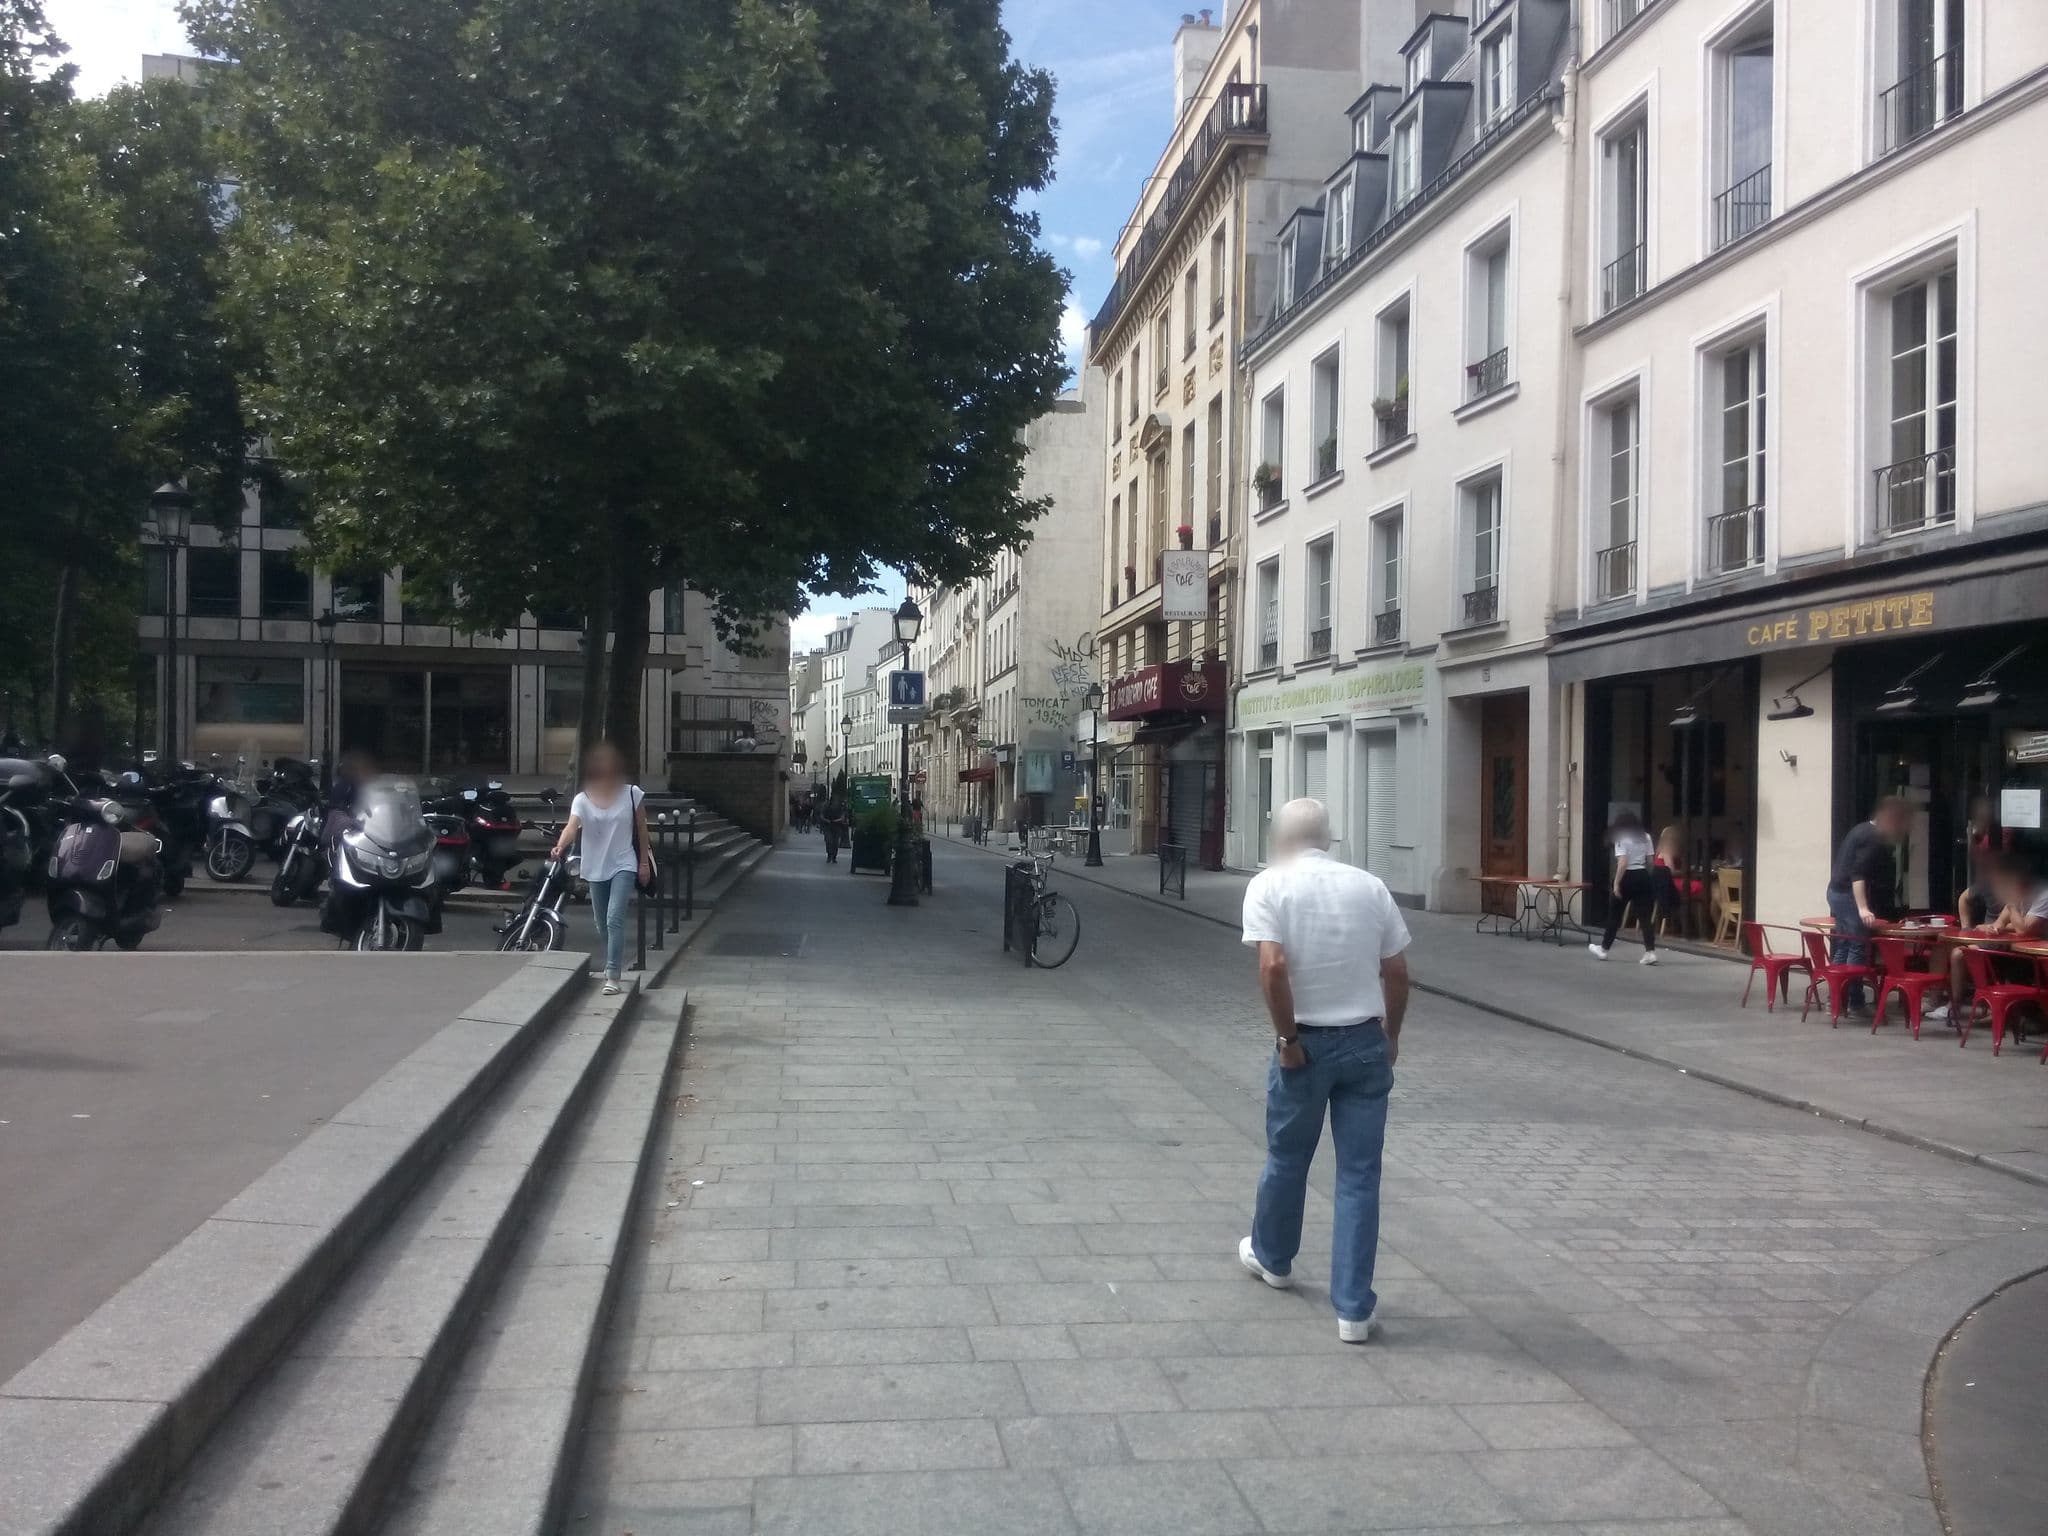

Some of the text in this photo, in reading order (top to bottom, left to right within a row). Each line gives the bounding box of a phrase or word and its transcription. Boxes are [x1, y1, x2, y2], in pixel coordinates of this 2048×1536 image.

[1747, 592, 1934, 645] CAFÉ PETITE
[1347, 666, 1424, 699] SOPHROLOGIE
[1020, 698, 1070, 709] TOMCAT
